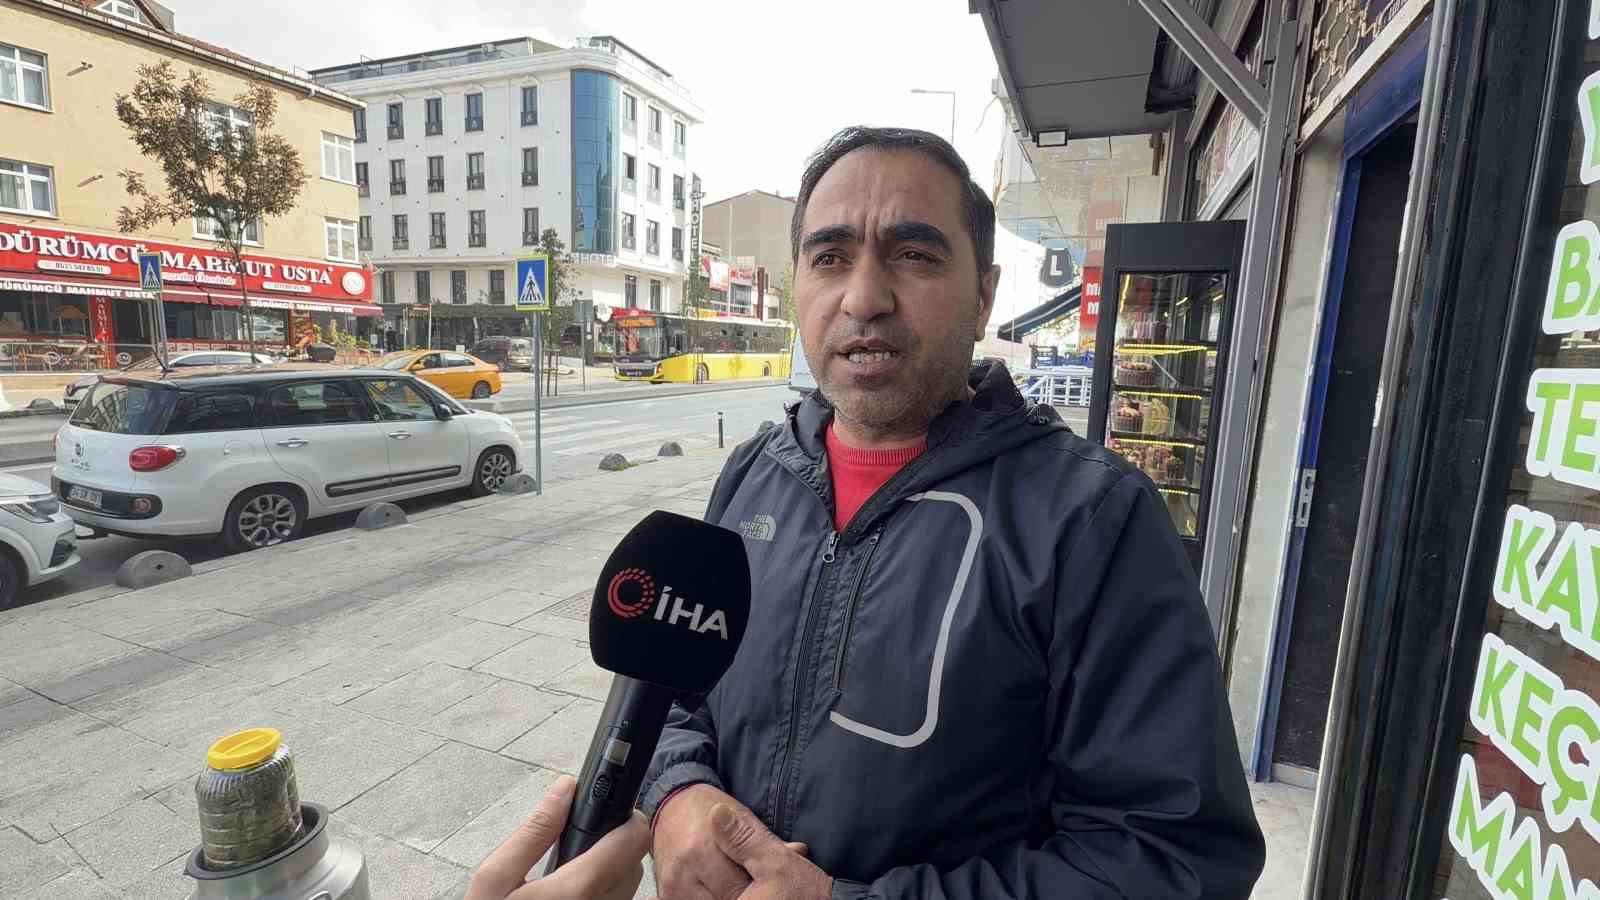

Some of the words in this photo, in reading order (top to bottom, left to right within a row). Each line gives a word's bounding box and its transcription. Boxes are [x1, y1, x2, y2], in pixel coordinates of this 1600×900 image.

[281, 265, 333, 285] USTA
[1552, 235, 1600, 321] B
[66, 286, 120, 297] MAHMUT
[1535, 382, 1600, 473] TE
[739, 521, 763, 531] NORTH
